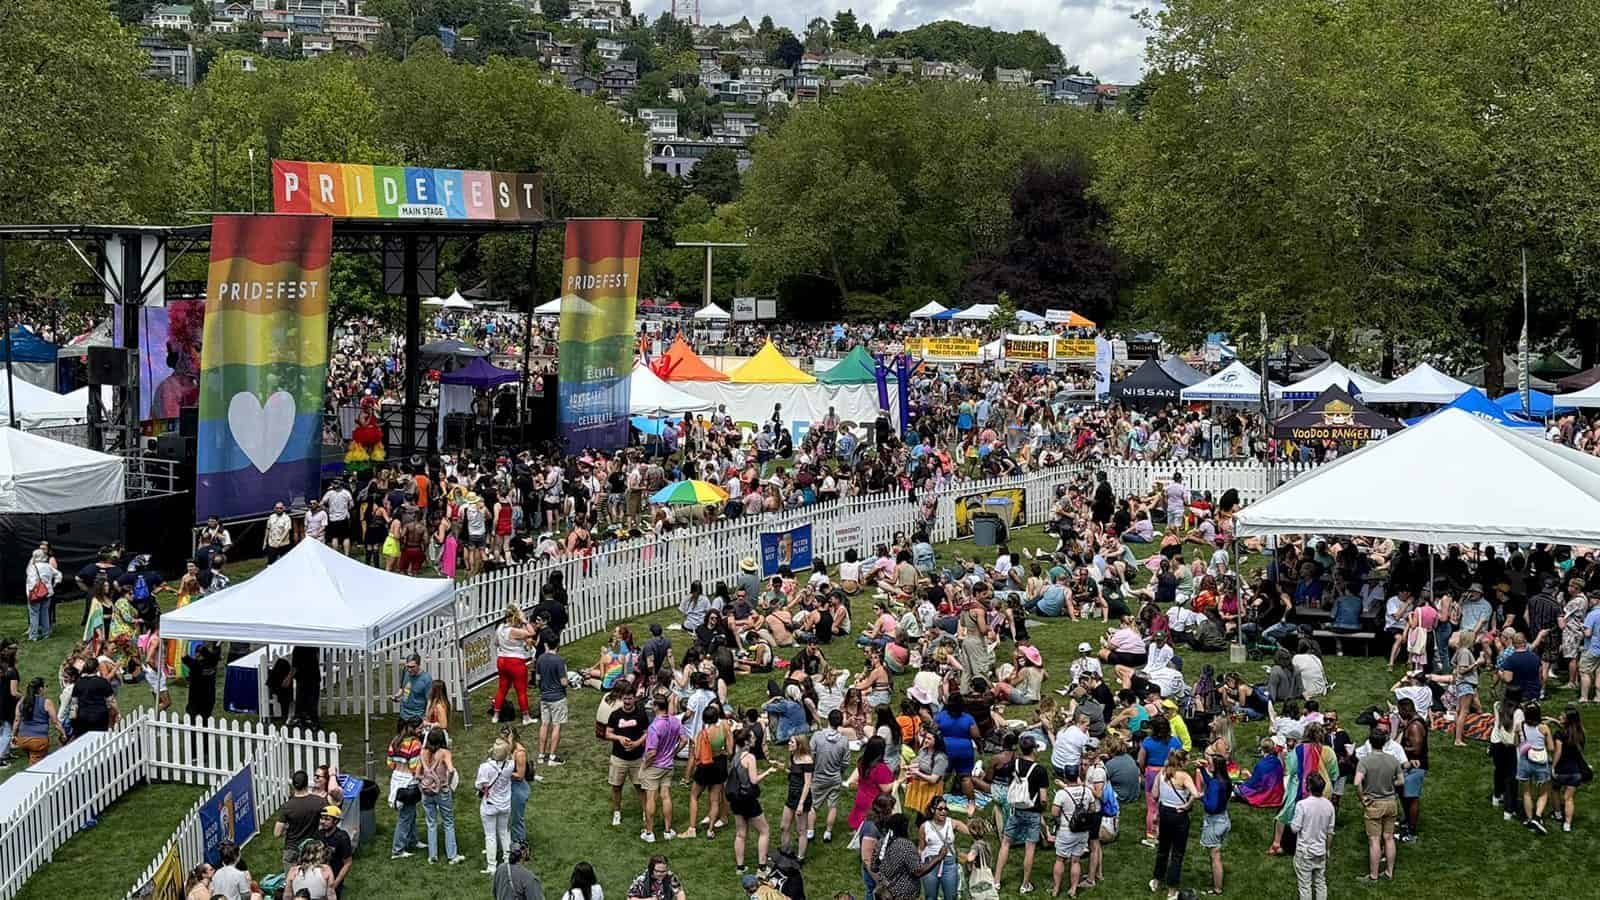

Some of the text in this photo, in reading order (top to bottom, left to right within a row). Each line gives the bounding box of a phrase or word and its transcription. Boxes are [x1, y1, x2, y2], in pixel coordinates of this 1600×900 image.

[284, 172, 534, 210] PRIDEFEST
[402, 206, 444, 217] MAIN STAGE
[567, 273, 629, 290] PRIDEFEST
[218, 281, 318, 300] PRIDEFEST
[1122, 387, 1175, 398] NISSAN
[1292, 428, 1388, 440] VOODOO RANGER IPA
